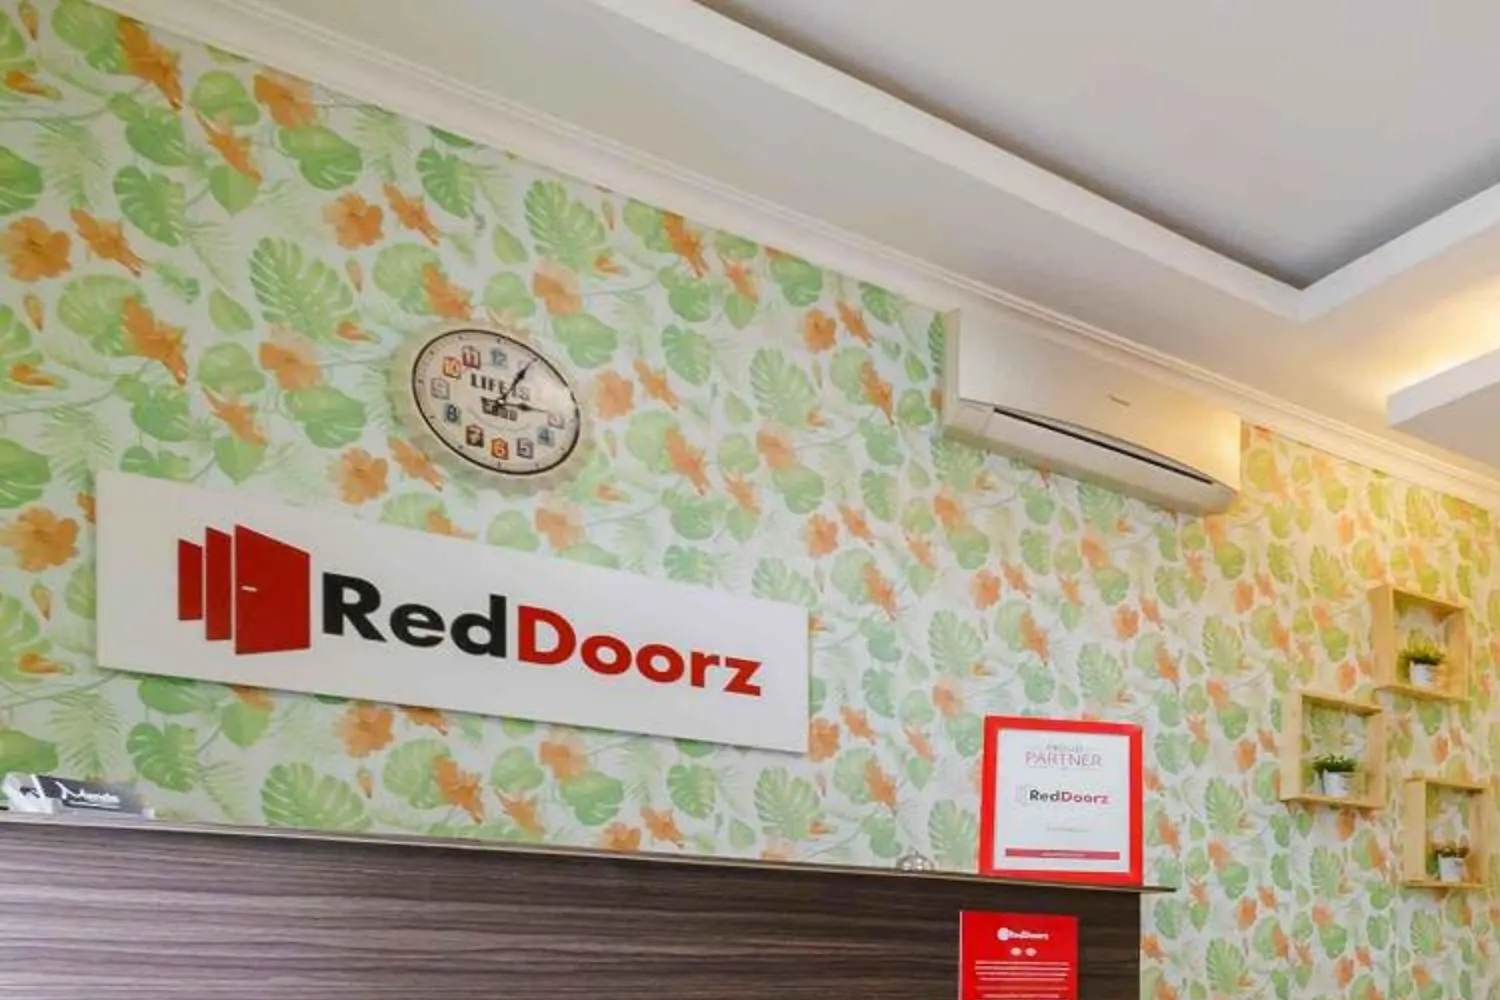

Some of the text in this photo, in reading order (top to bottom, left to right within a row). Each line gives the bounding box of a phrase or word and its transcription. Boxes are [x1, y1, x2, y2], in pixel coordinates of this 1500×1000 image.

[321, 570, 763, 697] RedDoorz
[1025, 751, 1103, 767] PARTNER
[1029, 789, 1110, 804] RedDoorz
